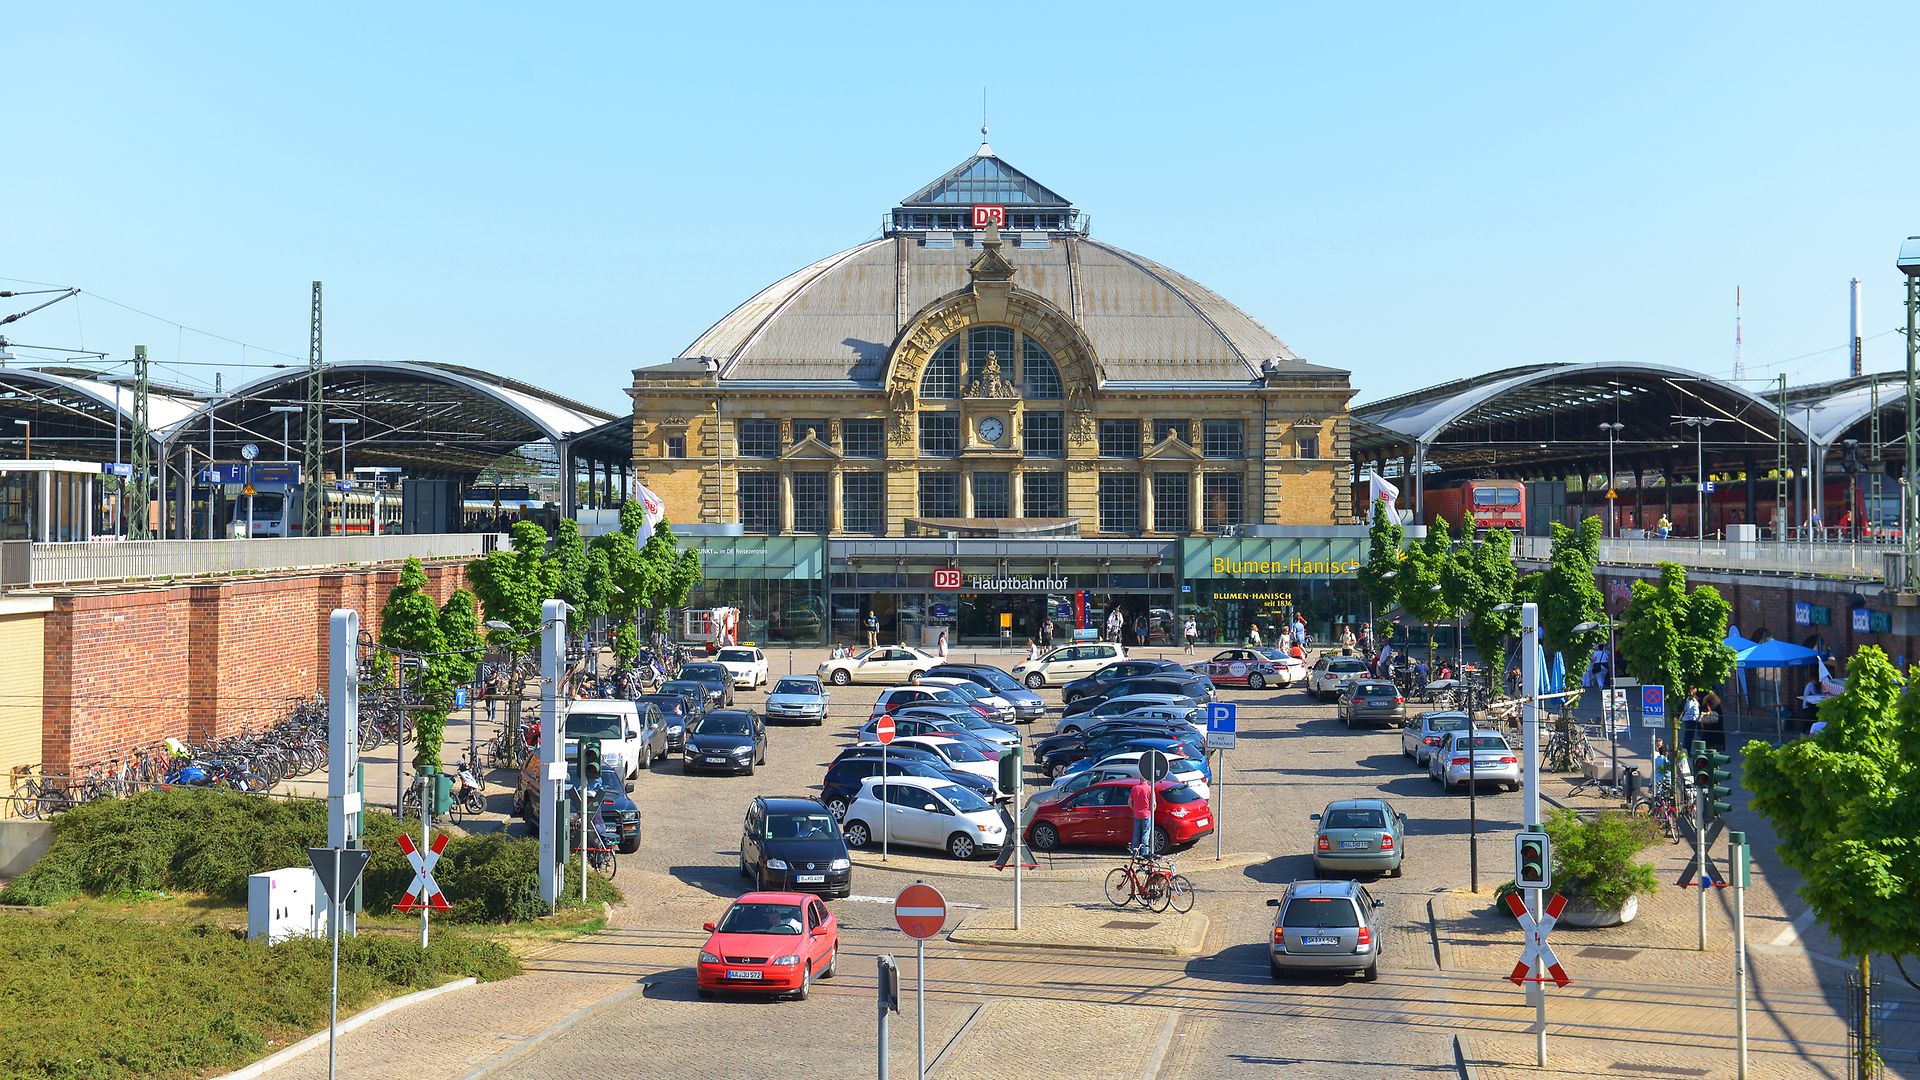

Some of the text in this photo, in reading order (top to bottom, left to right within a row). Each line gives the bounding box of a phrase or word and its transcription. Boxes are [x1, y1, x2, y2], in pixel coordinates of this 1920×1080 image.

[976, 208, 1002, 225] DB
[231, 467, 238, 478] F
[1707, 482, 1714, 491] E
[1213, 556, 1361, 574] Blumen-Hanisch
[936, 572, 959, 586] DB
[972, 577, 1069, 593] Hauptbahnhof
[1213, 707, 1230, 729] P
